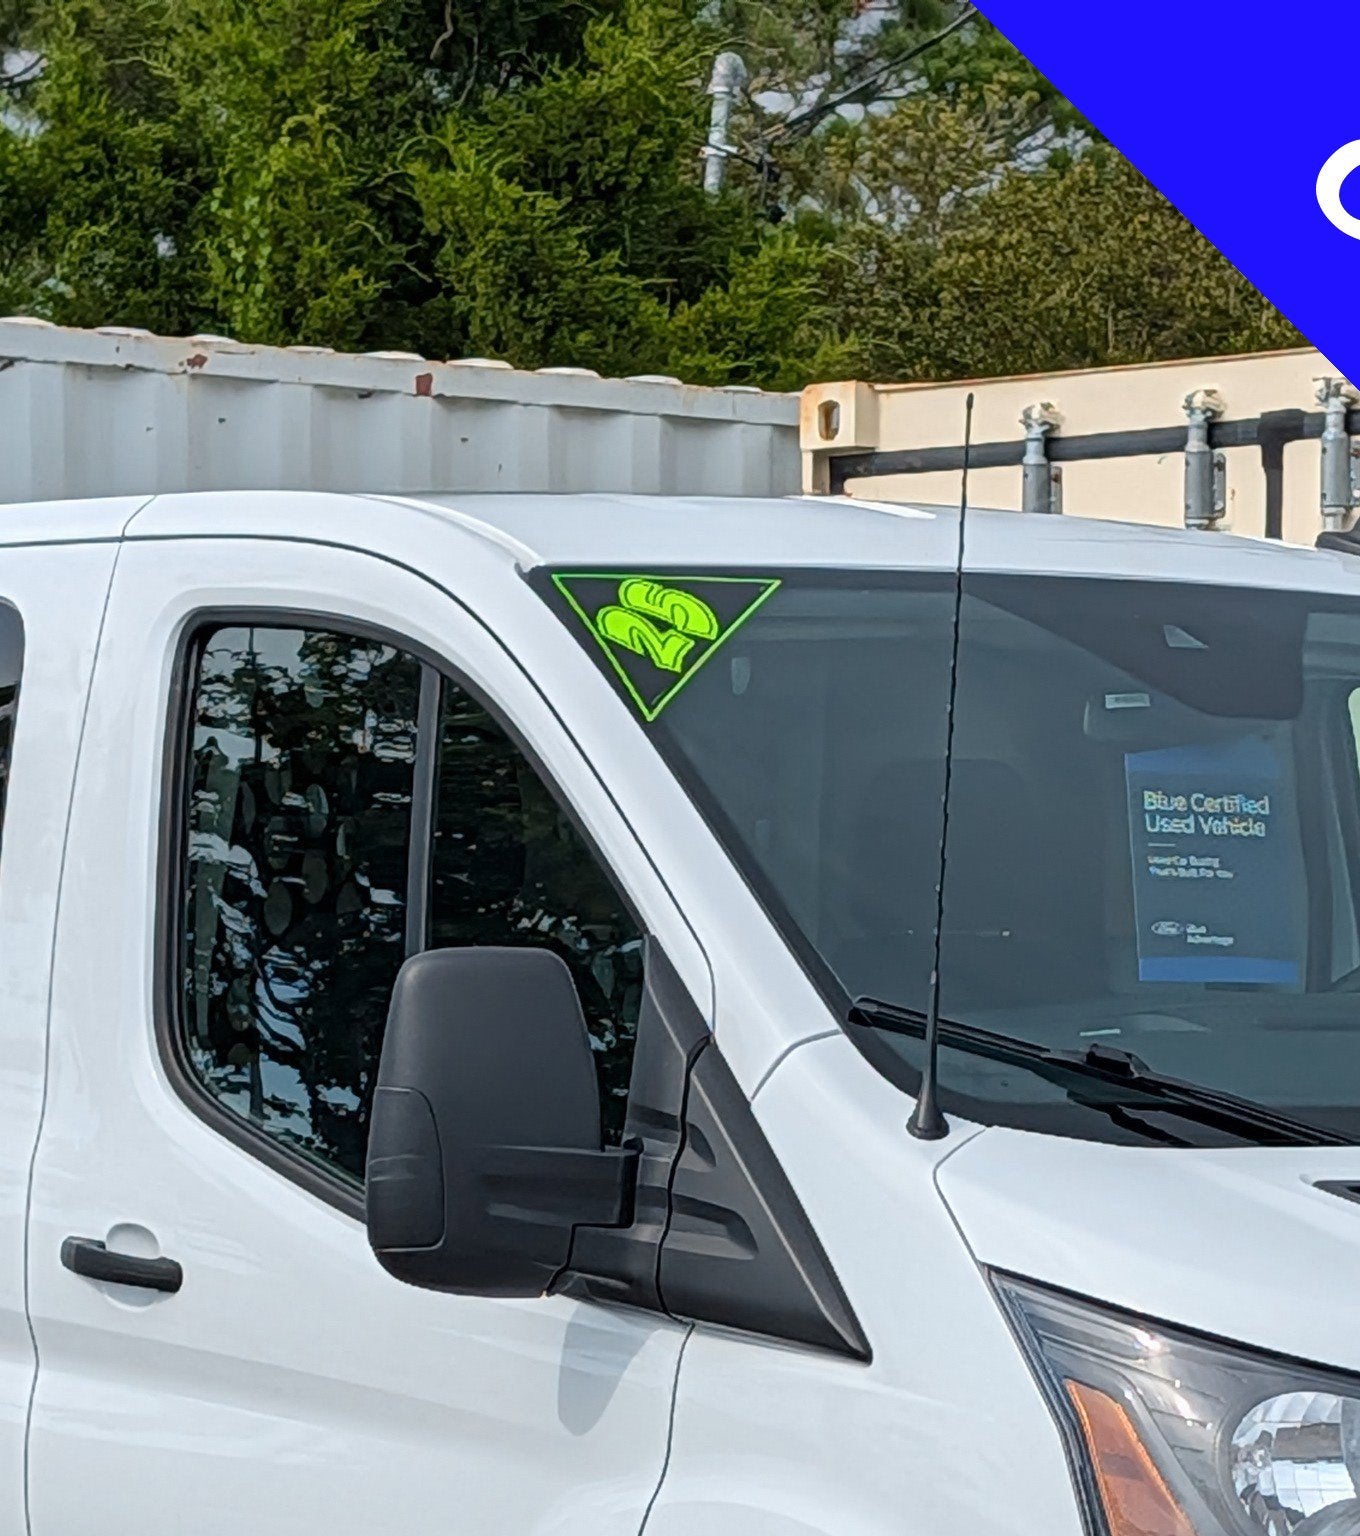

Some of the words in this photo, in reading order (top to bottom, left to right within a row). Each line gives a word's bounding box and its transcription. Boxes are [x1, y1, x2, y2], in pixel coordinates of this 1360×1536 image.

[1143, 790, 1188, 812] Blue
[1190, 793, 1270, 815] Certified
[1145, 813, 1195, 835] Used
[1197, 815, 1266, 837] Vehicle
